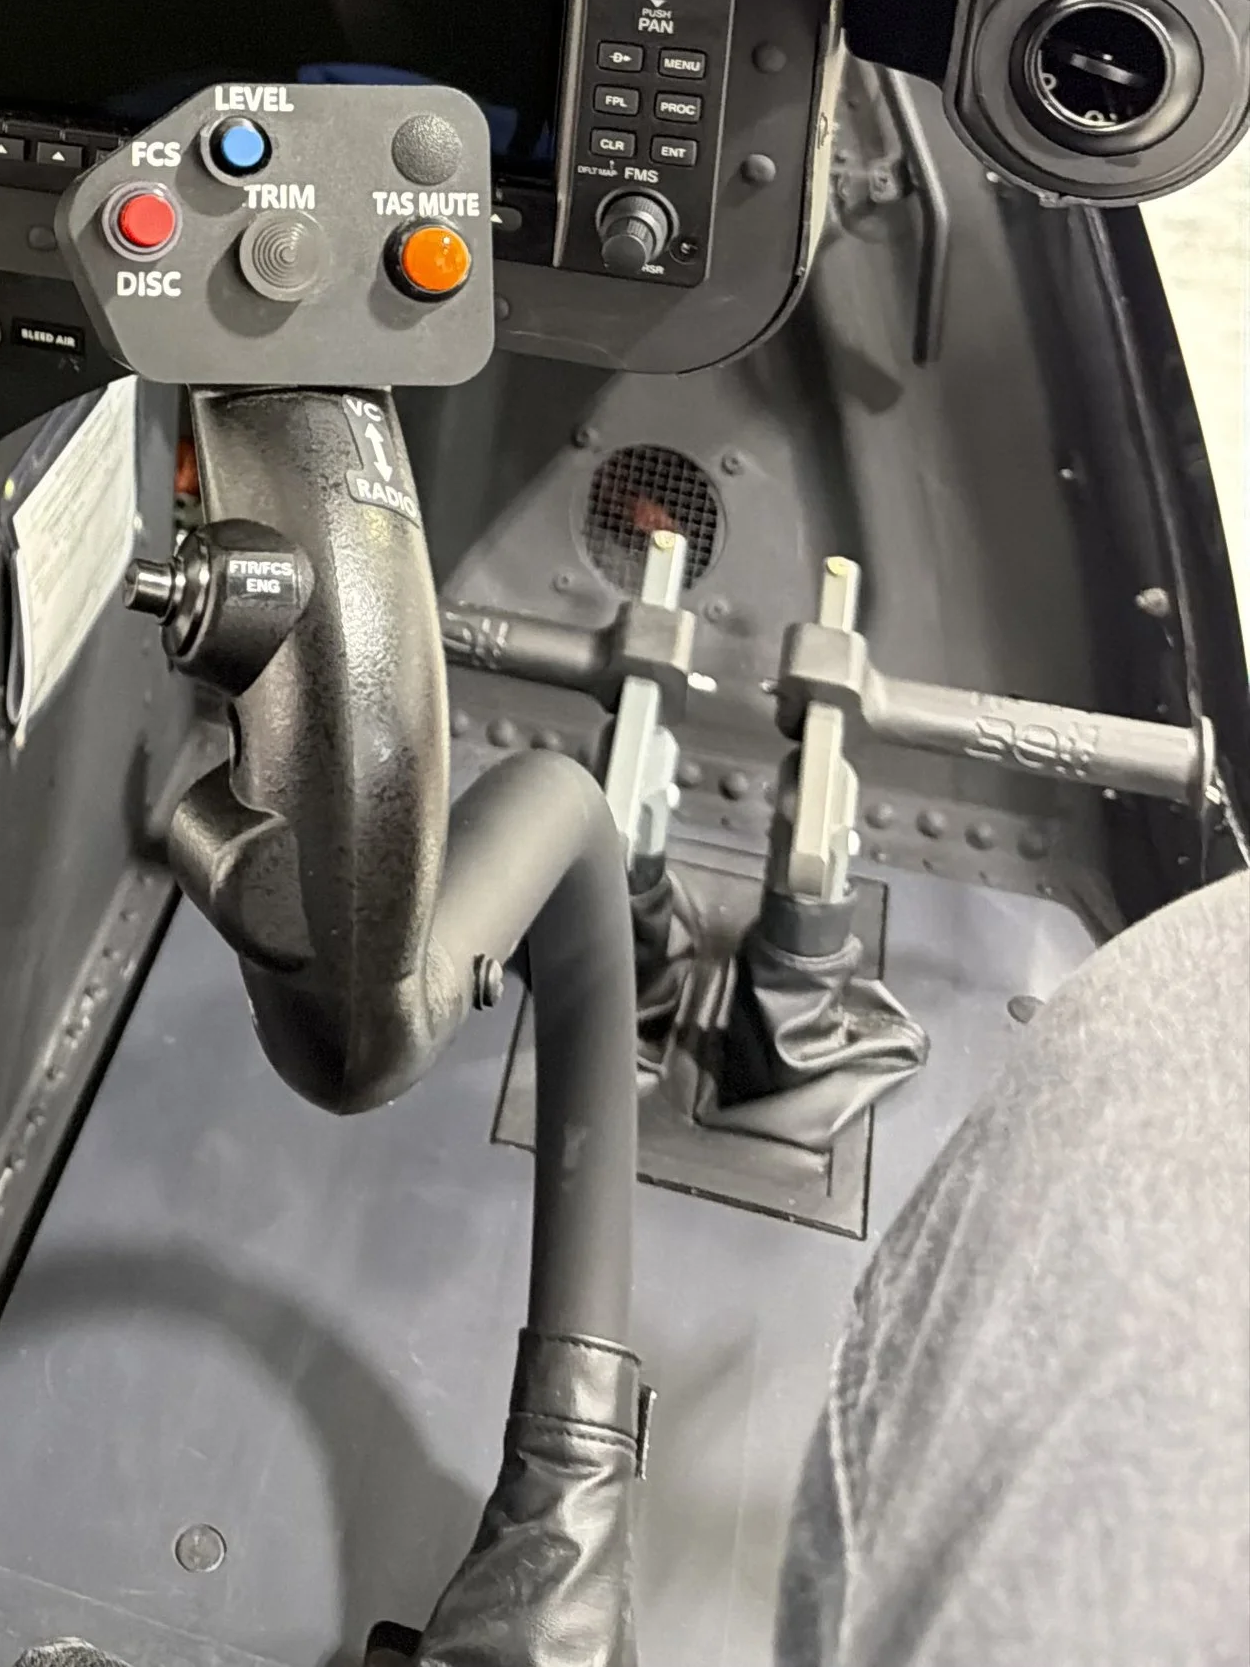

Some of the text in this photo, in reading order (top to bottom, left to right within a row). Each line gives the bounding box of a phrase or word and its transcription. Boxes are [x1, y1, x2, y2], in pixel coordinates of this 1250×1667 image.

[642, 8, 671, 18] PUSH
[638, 18, 673, 34] PAN
[664, 58, 700, 72] MENU
[215, 86, 294, 112] LEVEL
[605, 96, 627, 107] FPL
[661, 102, 696, 116] PROC
[600, 138, 624, 150] CLR
[131, 142, 180, 167] FCS
[661, 147, 686, 158] ENT
[624, 167, 658, 183] FMS
[245, 184, 315, 210] TRIM
[373, 192, 479, 216] TAS MUTE
[117, 271, 181, 296] DISC
[21, 328, 75, 347] BLEED AIR
[346, 398, 382, 421] VC
[356, 478, 417, 518] RADIO
[230, 560, 293, 576] FTR/FCS
[246, 579, 280, 594] ENG
